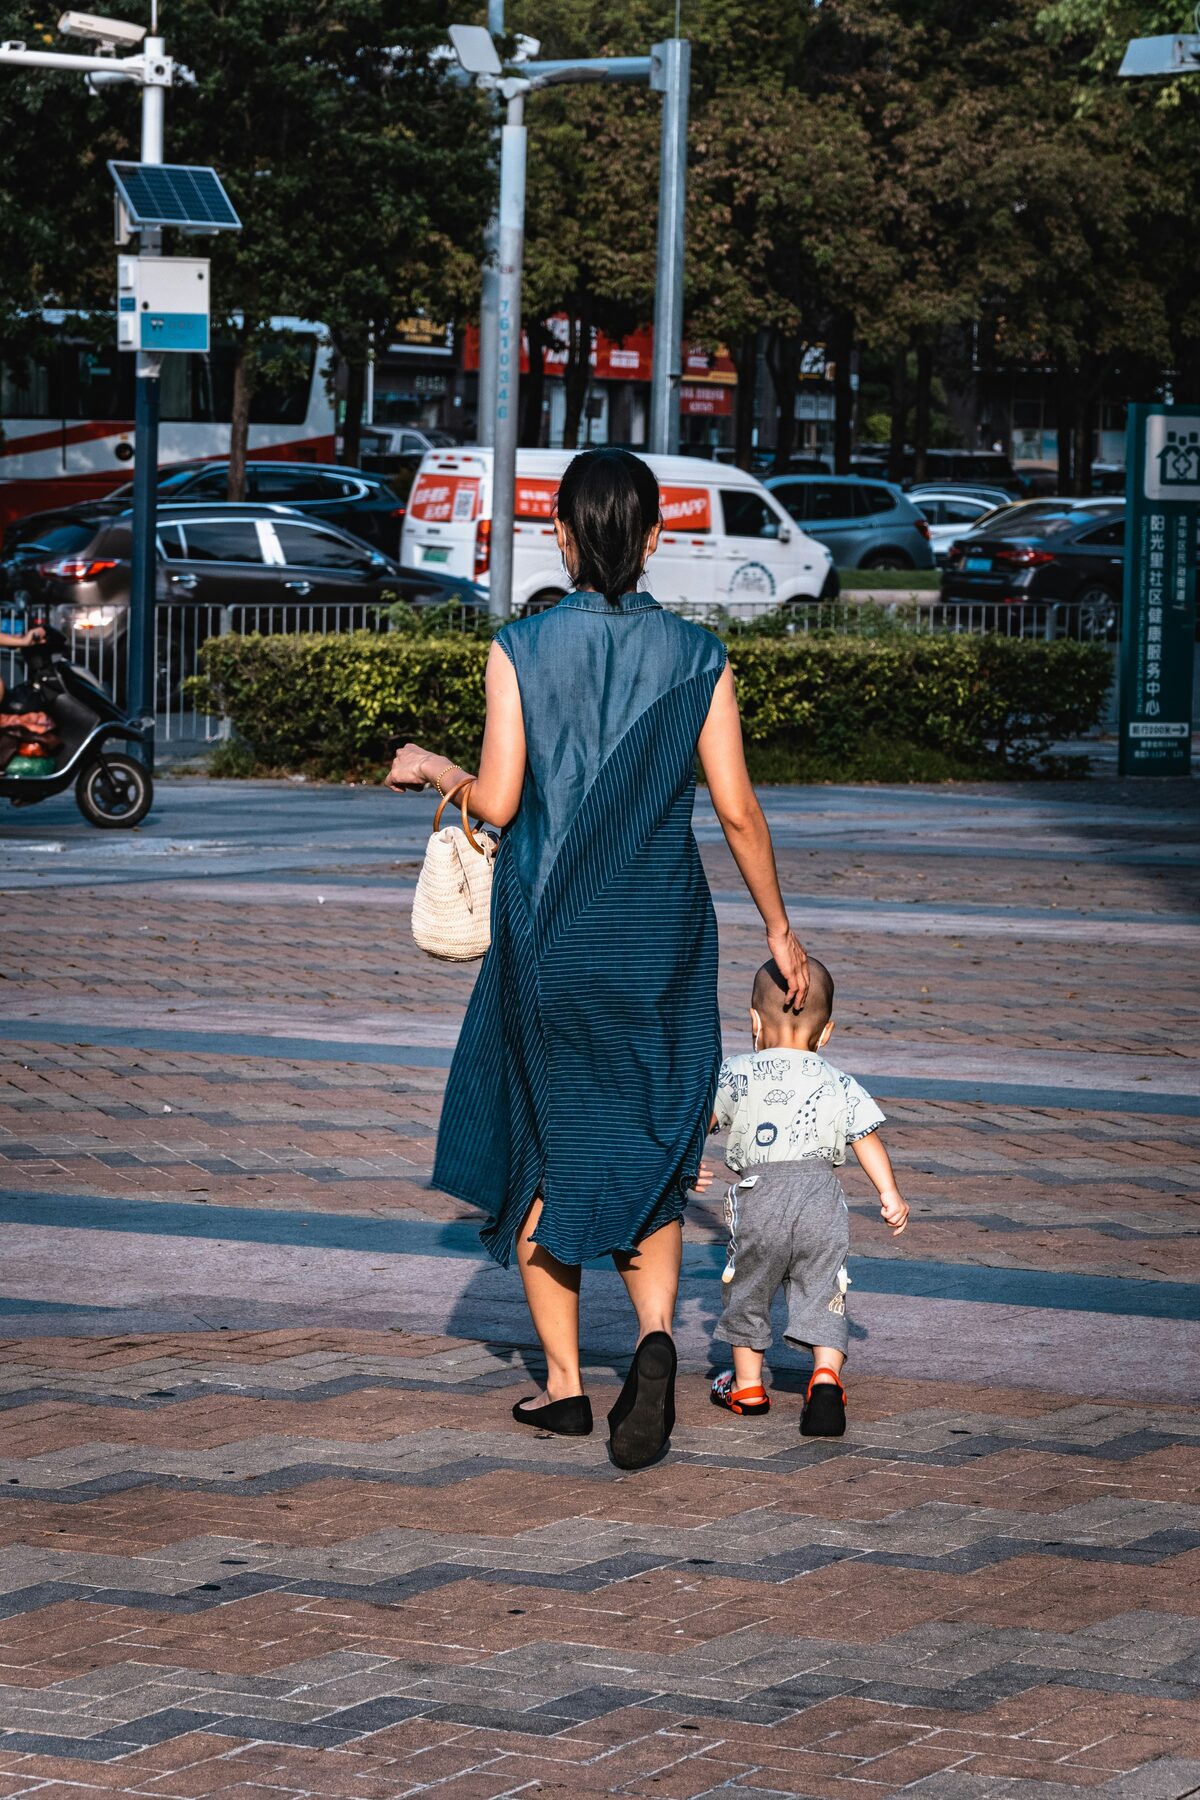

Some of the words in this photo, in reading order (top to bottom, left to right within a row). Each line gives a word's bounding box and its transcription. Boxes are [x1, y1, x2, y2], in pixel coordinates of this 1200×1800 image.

[496, 300, 510, 419] 7610346
[1145, 514, 1165, 717] 阳光里社区健康服务中心
